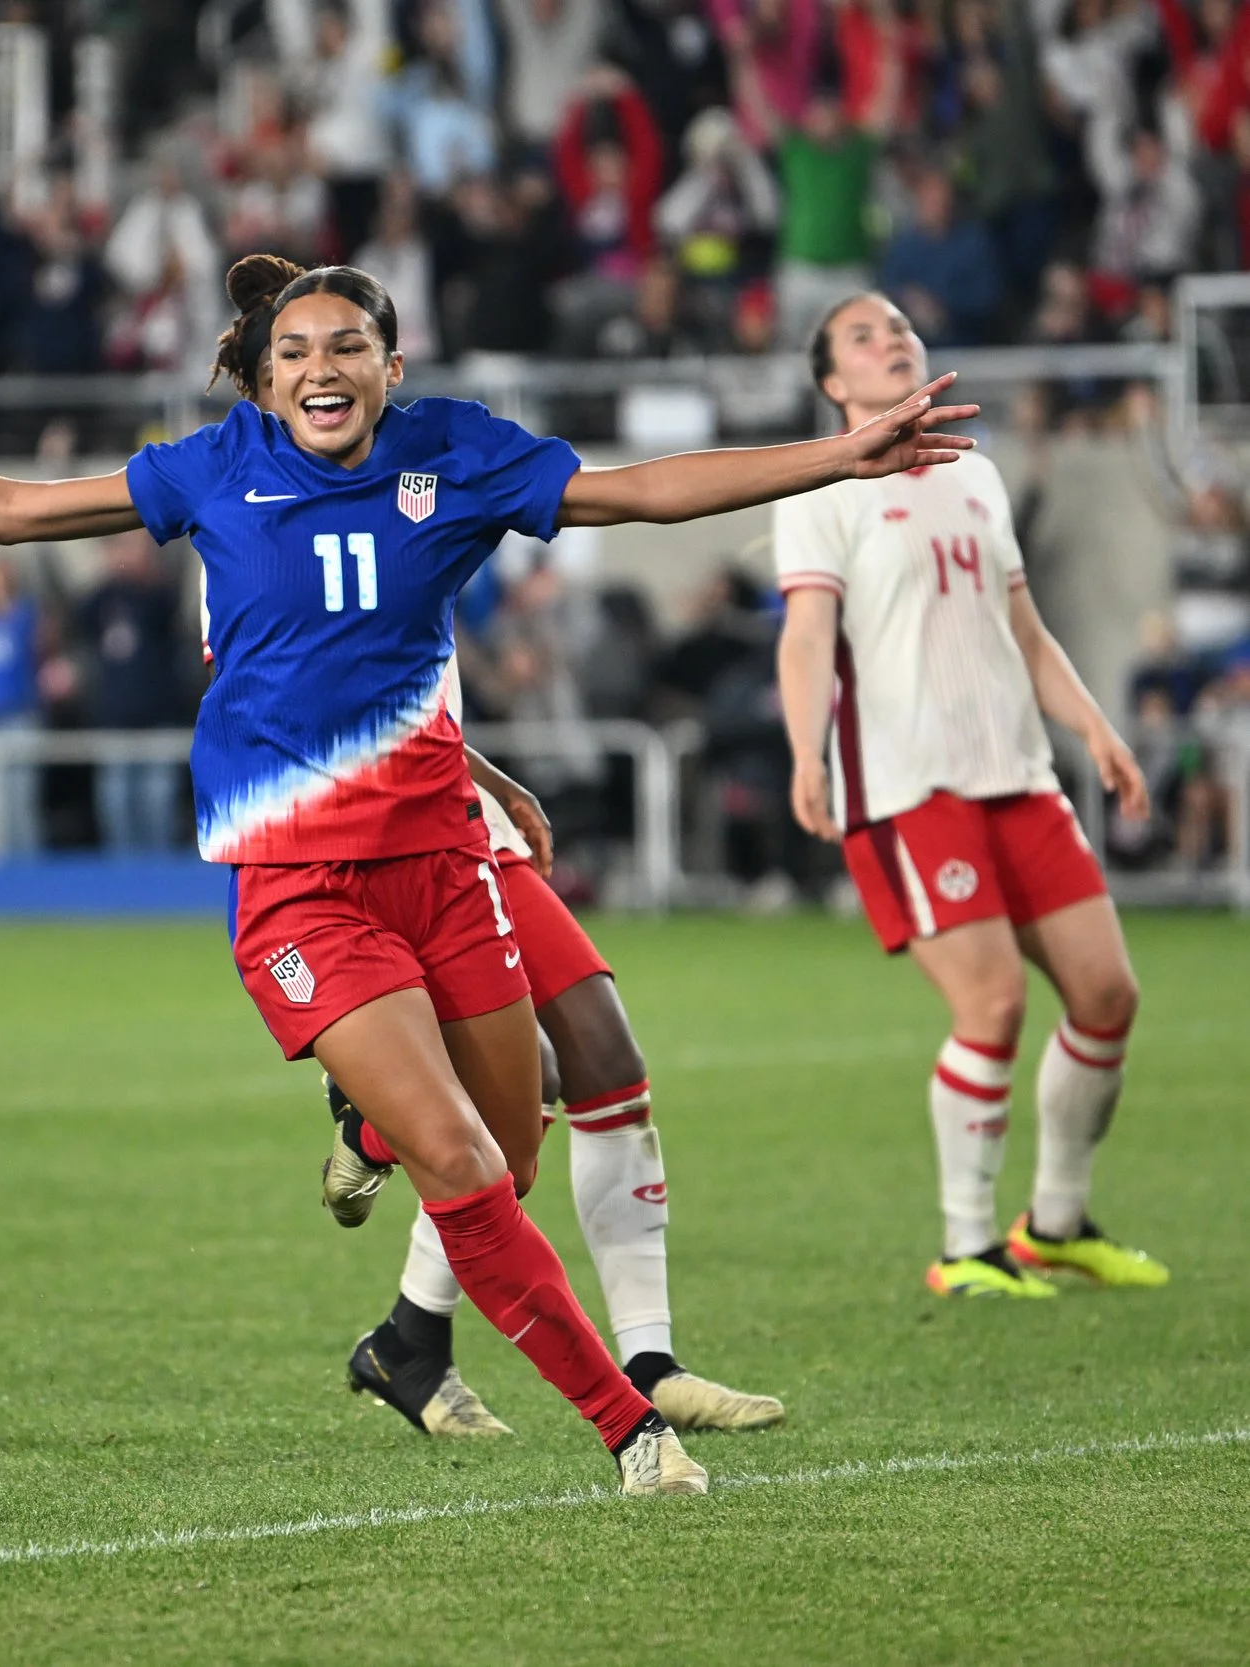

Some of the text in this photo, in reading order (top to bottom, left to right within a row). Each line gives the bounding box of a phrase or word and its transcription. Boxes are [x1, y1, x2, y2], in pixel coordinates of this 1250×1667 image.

[401, 474, 435, 495] USA
[313, 532, 378, 612] 11
[930, 534, 985, 597] 14
[273, 952, 301, 980] USA
